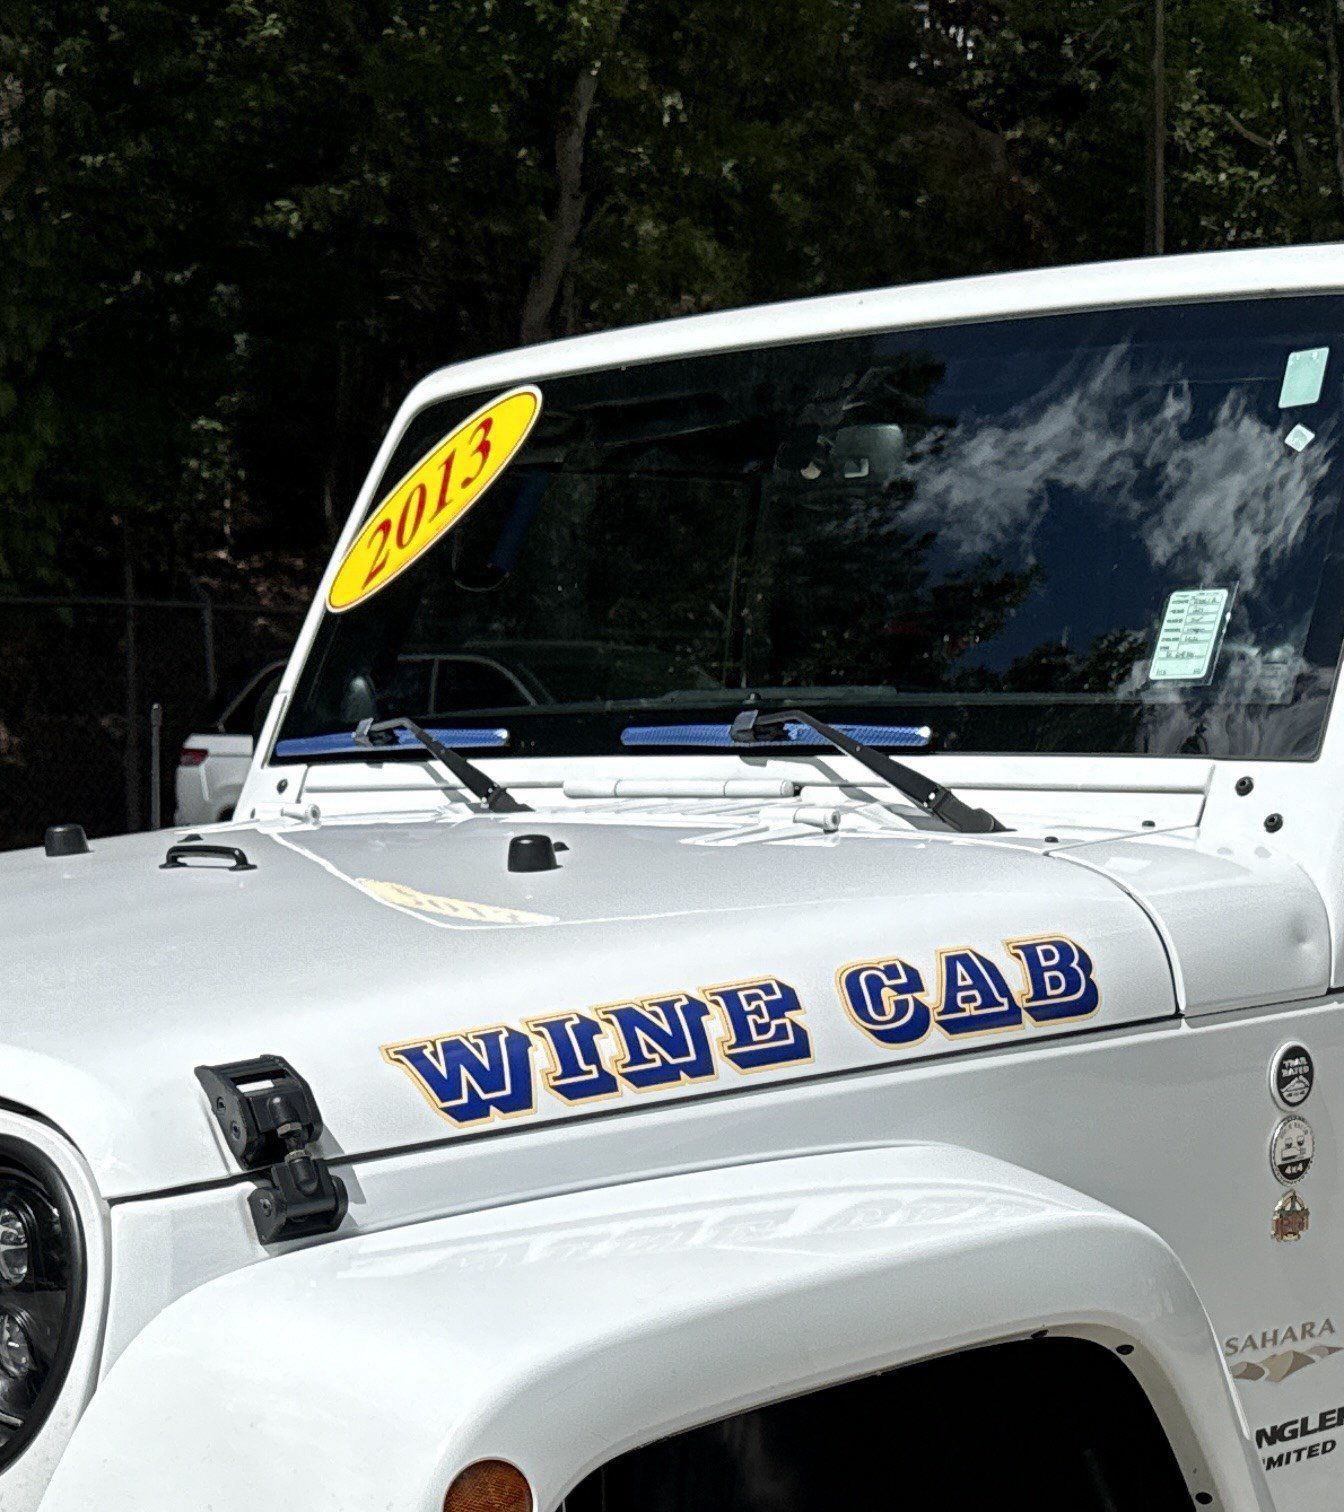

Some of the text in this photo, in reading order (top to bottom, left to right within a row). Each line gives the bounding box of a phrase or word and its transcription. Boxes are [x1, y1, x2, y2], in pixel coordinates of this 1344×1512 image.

[361, 416, 493, 592] 2013
[380, 931, 1102, 1128] WINE CAB
[1224, 1318, 1336, 1357] SAHARA
[1261, 1439, 1337, 1472] MITED
